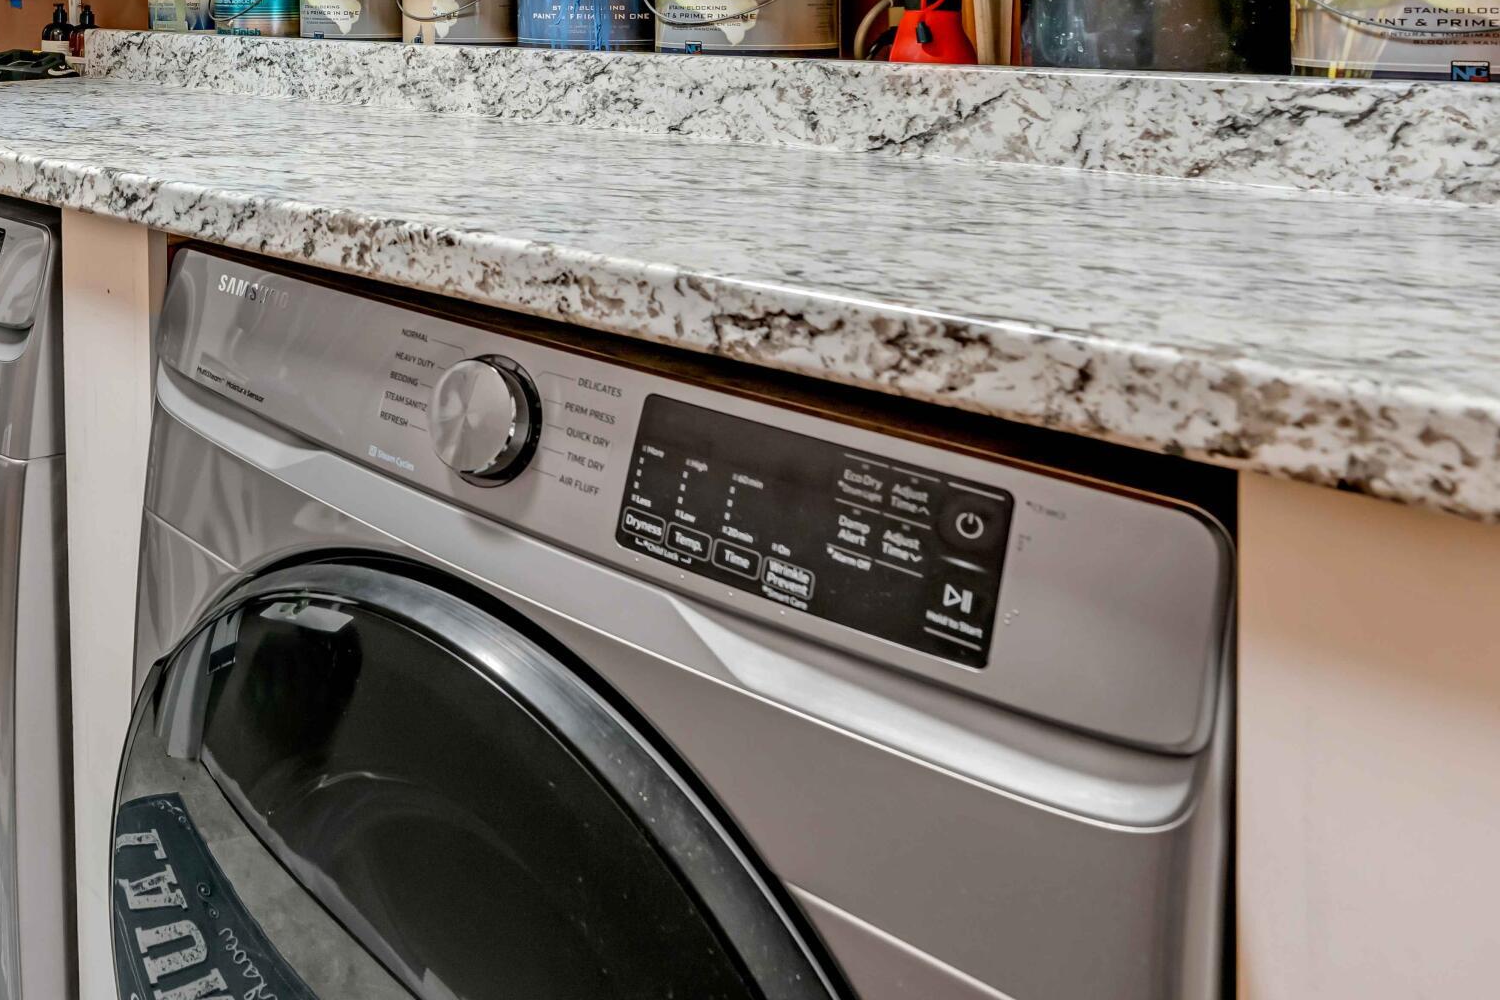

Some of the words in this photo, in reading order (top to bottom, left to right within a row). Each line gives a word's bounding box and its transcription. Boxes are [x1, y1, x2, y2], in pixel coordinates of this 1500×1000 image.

[233, 28, 261, 36] Finish
[1415, 18, 1428, 27] &
[1437, 18, 1500, 27] PRIME
[401, 328, 428, 343] NORMAL
[395, 351, 416, 364] HEAVY
[417, 357, 435, 369] DUTY
[390, 370, 419, 386] BEDDING
[577, 377, 622, 398] DELICATES
[385, 390, 405, 402] STEAM
[405, 395, 428, 412] SANITIZ
[380, 410, 409, 427] REFRESH
[564, 401, 588, 416] PERM
[589, 409, 616, 425] PRESS
[566, 426, 591, 442] QUICK
[592, 435, 610, 448] DRY
[567, 451, 586, 466] TIME
[587, 459, 605, 472] DRY
[559, 474, 573, 487] AIR
[574, 480, 600, 496] FLUFF
[892, 484, 928, 503] Adjust
[891, 495, 918, 514] Time
[625, 513, 662, 536] Dryness
[838, 514, 871, 535] Damp
[837, 528, 866, 547] Alert
[883, 529, 920, 550] Adjust
[724, 549, 750, 569] Time
[882, 541, 909, 561] Time
[769, 560, 810, 584] Wrinkle
[766, 571, 808, 596] Prevent
[959, 621, 983, 639] Start
